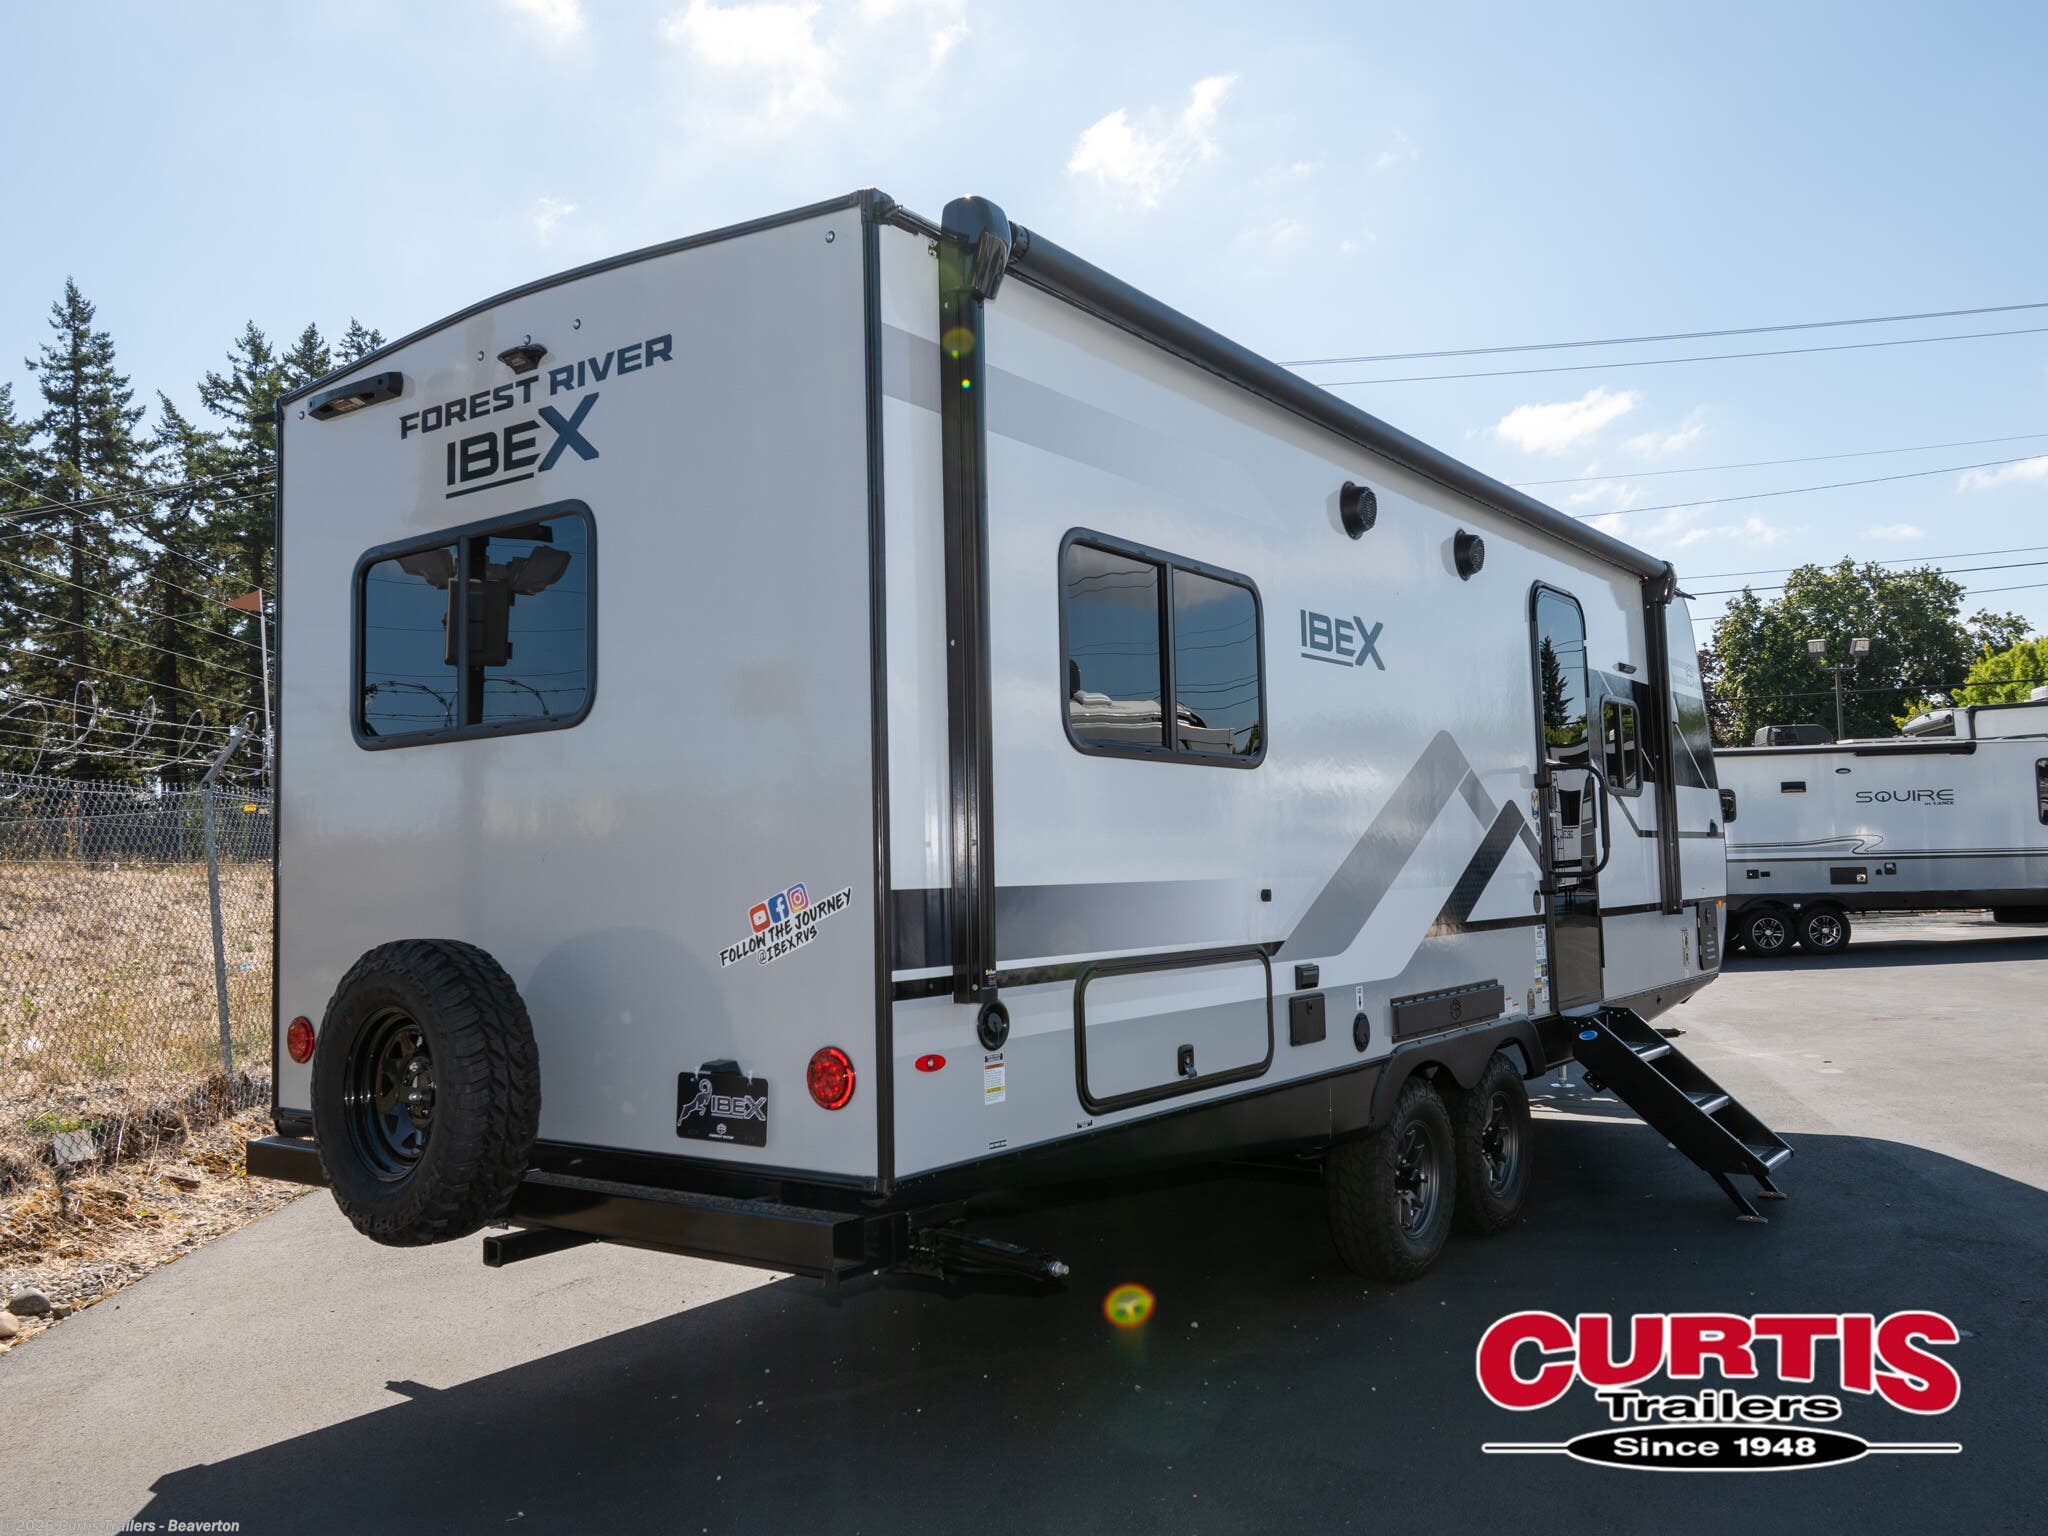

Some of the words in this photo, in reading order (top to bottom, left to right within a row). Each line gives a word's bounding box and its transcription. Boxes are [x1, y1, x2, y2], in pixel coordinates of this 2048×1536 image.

[400, 376, 539, 439] FOREST
[548, 334, 673, 395] RIVER
[446, 392, 599, 488] IBEX
[1300, 609, 1385, 671] IBEX
[1856, 789, 1954, 803] SQUIRE
[720, 932, 766, 966] FOLLOW
[768, 919, 792, 942] THE
[794, 888, 851, 929] JOURNEY
[711, 1095, 767, 1121] IBEX
